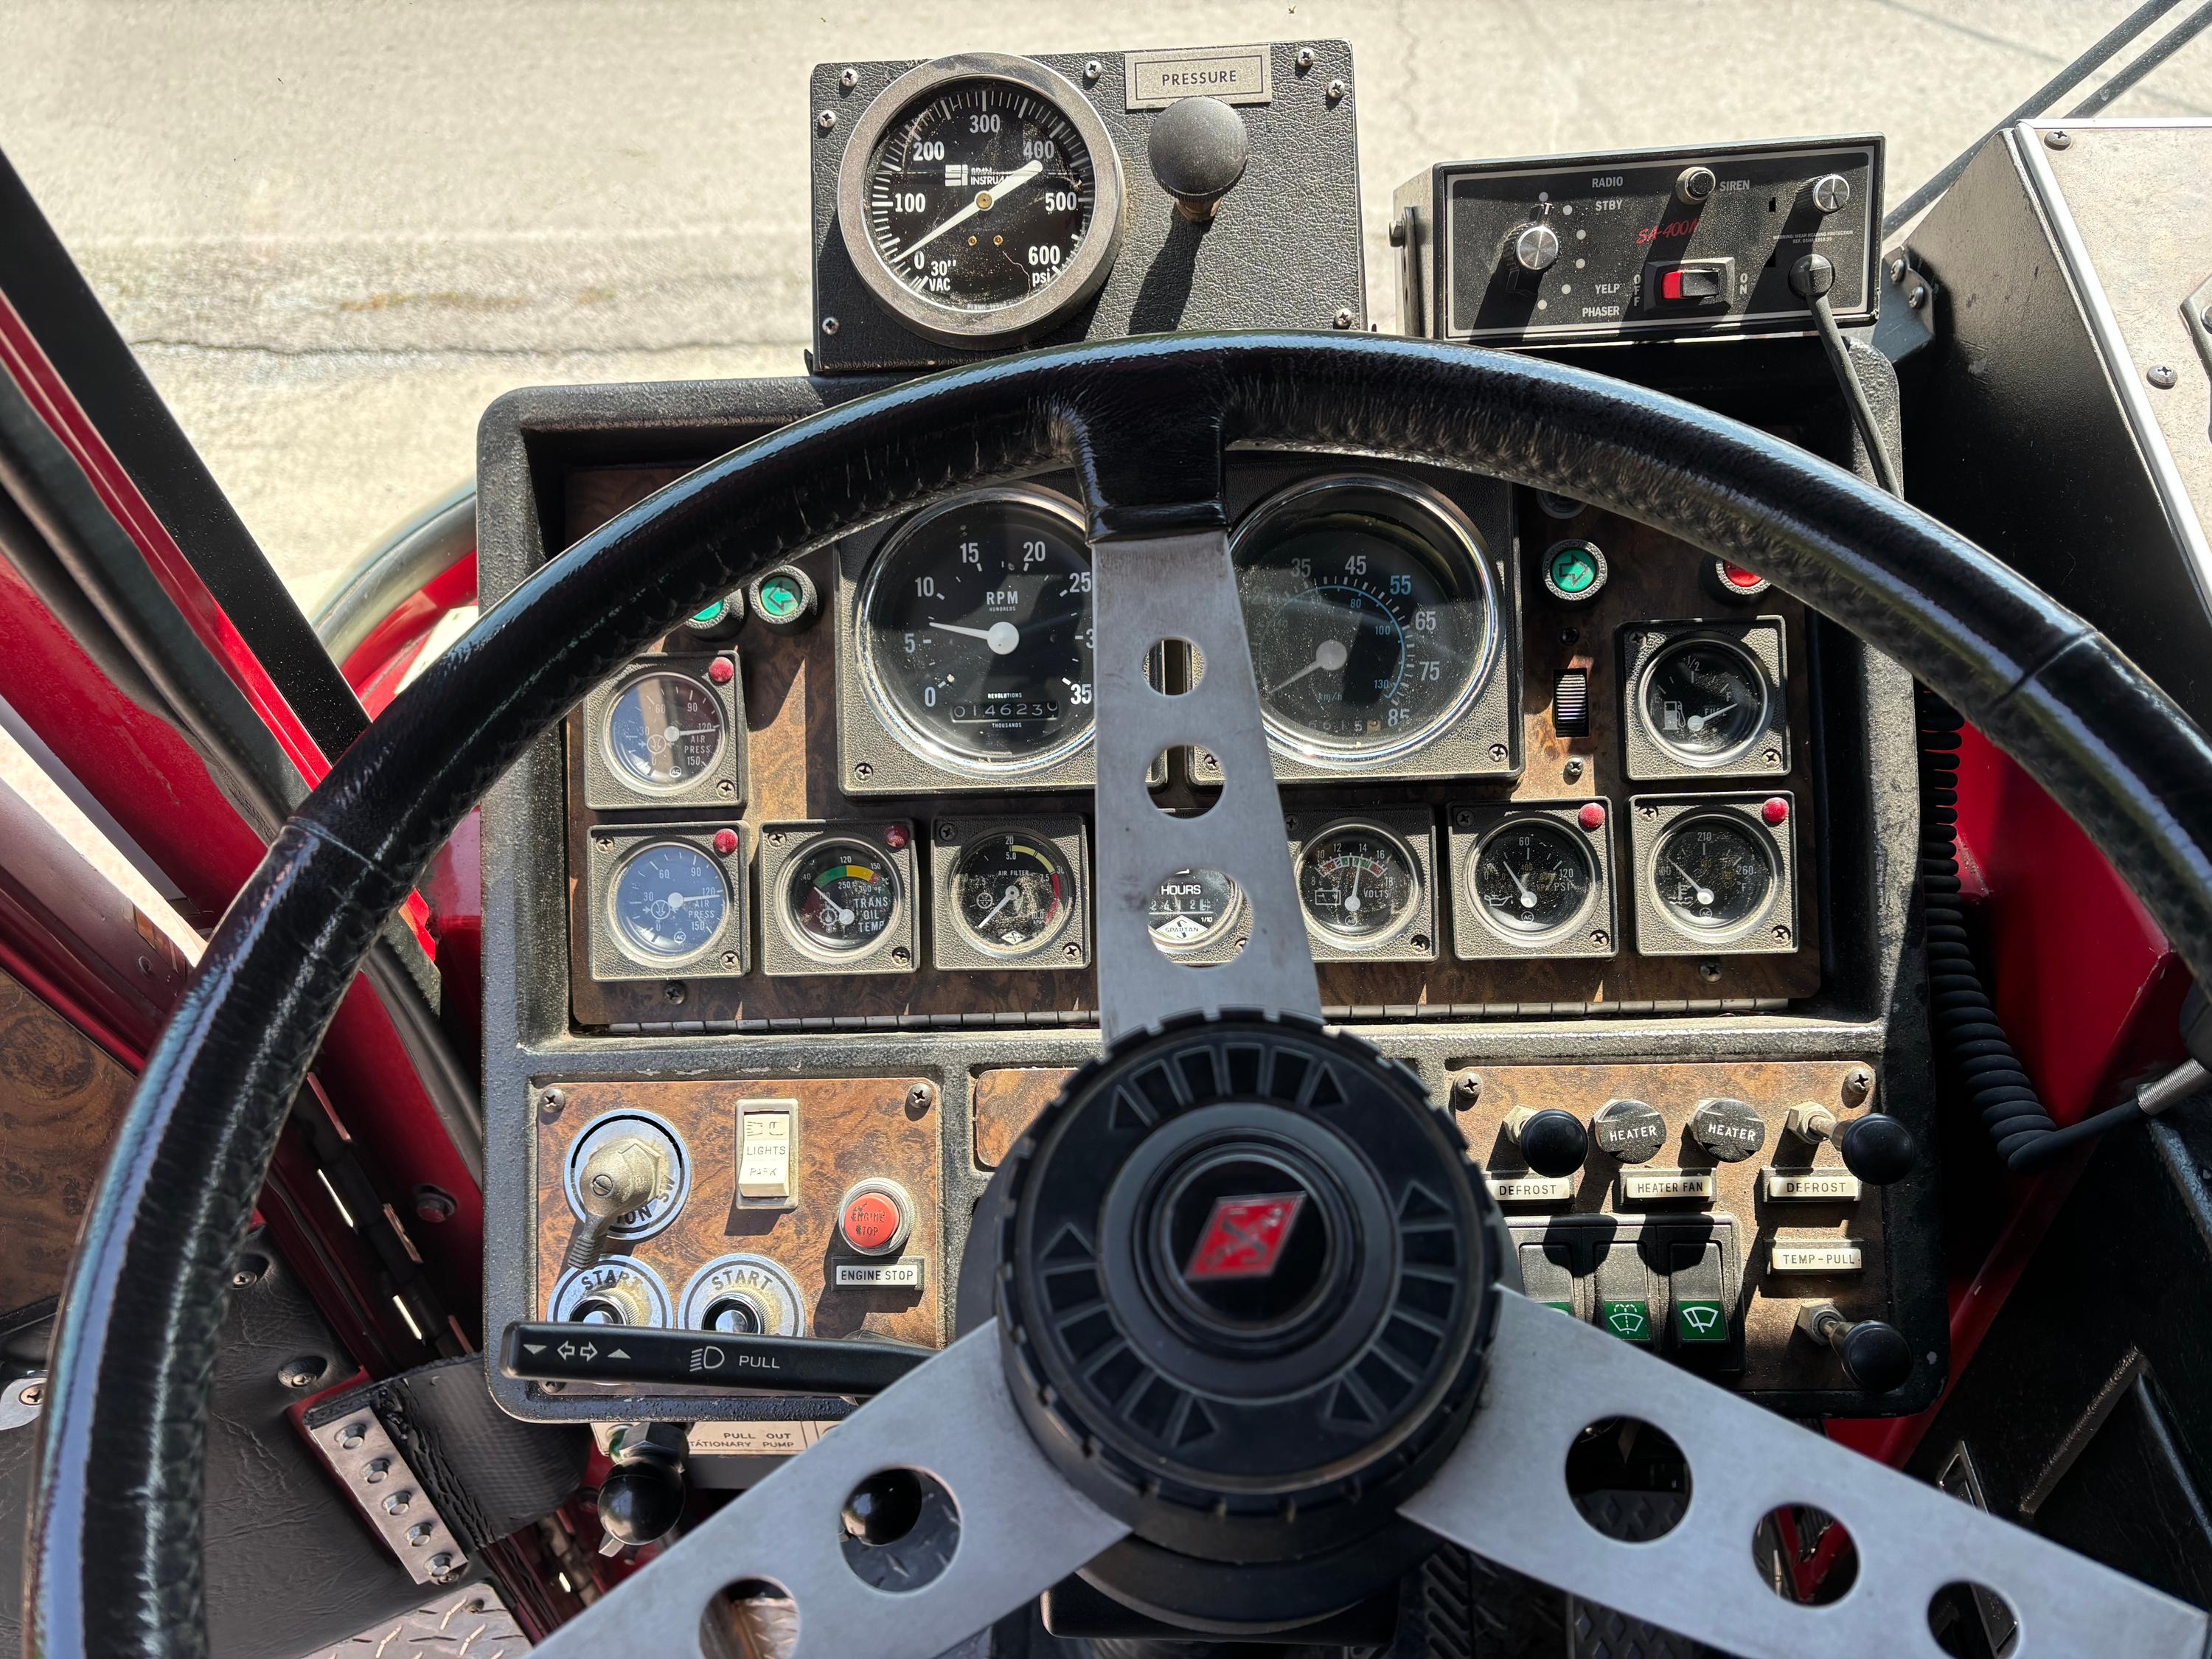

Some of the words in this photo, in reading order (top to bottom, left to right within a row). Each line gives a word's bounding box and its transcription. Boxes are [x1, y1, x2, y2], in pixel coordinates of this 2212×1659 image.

[1162, 70, 1237, 86] PRESSURE
[969, 114, 1001, 133] 300
[913, 141, 945, 161] 200
[1023, 141, 1055, 159] 400
[1592, 176, 1624, 189] RADIO
[1719, 179, 1750, 192] SIREN
[894, 193, 926, 212] 100
[1045, 192, 1077, 212] 500
[1596, 199, 1622, 212] STBY
[914, 251, 925, 270] 0
[1028, 246, 1060, 265] 600
[929, 277, 952, 292] VAC
[1032, 271, 1051, 287] psi
[1595, 284, 1620, 294] YELP
[1582, 306, 1620, 317] PHASER
[960, 542, 980, 564] 15
[1023, 541, 1046, 562] 20
[1291, 557, 1312, 579] 35
[1345, 555, 1367, 576] 45
[915, 577, 935, 597] 10
[1069, 571, 1091, 593] 25
[1390, 575, 1411, 596] 55
[987, 591, 1019, 605] RPM
[1350, 598, 1362, 609] 80
[1415, 611, 1436, 632] 65
[1375, 625, 1391, 636] 100
[905, 633, 916, 653] 5
[1086, 629, 1094, 650] 3
[1419, 661, 1440, 681] 75
[1374, 679, 1389, 689] 130
[925, 686, 936, 708] 0
[1070, 684, 1092, 704] 35
[655, 704, 666, 714] 60
[686, 702, 698, 713] 90
[1388, 708, 1410, 728] 85
[639, 726, 650, 737] 30
[698, 723, 712, 731] 120
[690, 735, 706, 743] AIR
[684, 745, 711, 754] PRESS
[687, 757, 700, 766] 150
[1005, 836, 1014, 845] 20
[1519, 836, 1530, 846] 60
[1697, 832, 1711, 841] 210
[1333, 843, 1342, 852] 12
[1359, 843, 1368, 852] 14
[840, 855, 852, 864] 120
[1006, 852, 1017, 860] 5.0
[1317, 849, 1325, 859] 10
[1377, 850, 1385, 860] 16
[659, 869, 669, 879] 60
[691, 867, 701, 877] 90
[1559, 868, 1573, 878] 120
[1737, 866, 1753, 875] 260
[1040, 874, 1050, 883] 7.5
[1311, 877, 1315, 886] 8
[1385, 877, 1394, 886] 18
[838, 881, 851, 890] 250
[859, 885, 872, 894] 300
[1161, 884, 1201, 895] HOURS
[1554, 882, 1570, 891] PSI
[643, 891, 654, 901] 30
[702, 887, 715, 897] 120
[1363, 889, 1390, 898] VOLTS
[695, 900, 710, 908] AIR
[855, 897, 888, 908] TRANS
[689, 910, 714, 919] PRESS
[863, 910, 880, 919] OIL
[691, 922, 705, 931] 150
[859, 921, 885, 933] TEMP
[1610, 1125, 1658, 1142] HEATER
[1708, 1124, 1757, 1141] HEATER
[746, 1146, 786, 1155] LIGHTS
[1499, 1184, 1557, 1196] DEFROST
[1638, 1182, 1678, 1193] HEATER
[1683, 1181, 1703, 1192] FAN
[1787, 1182, 1846, 1193] DEFROST
[851, 1211, 886, 1223] ENGINE
[855, 1225, 879, 1237] STOP
[581, 1269, 644, 1290] START
[712, 1269, 773, 1290] START
[841, 1270, 881, 1281] ENGINE
[885, 1270, 914, 1281] STOP
[739, 1354, 781, 1370] PULL
